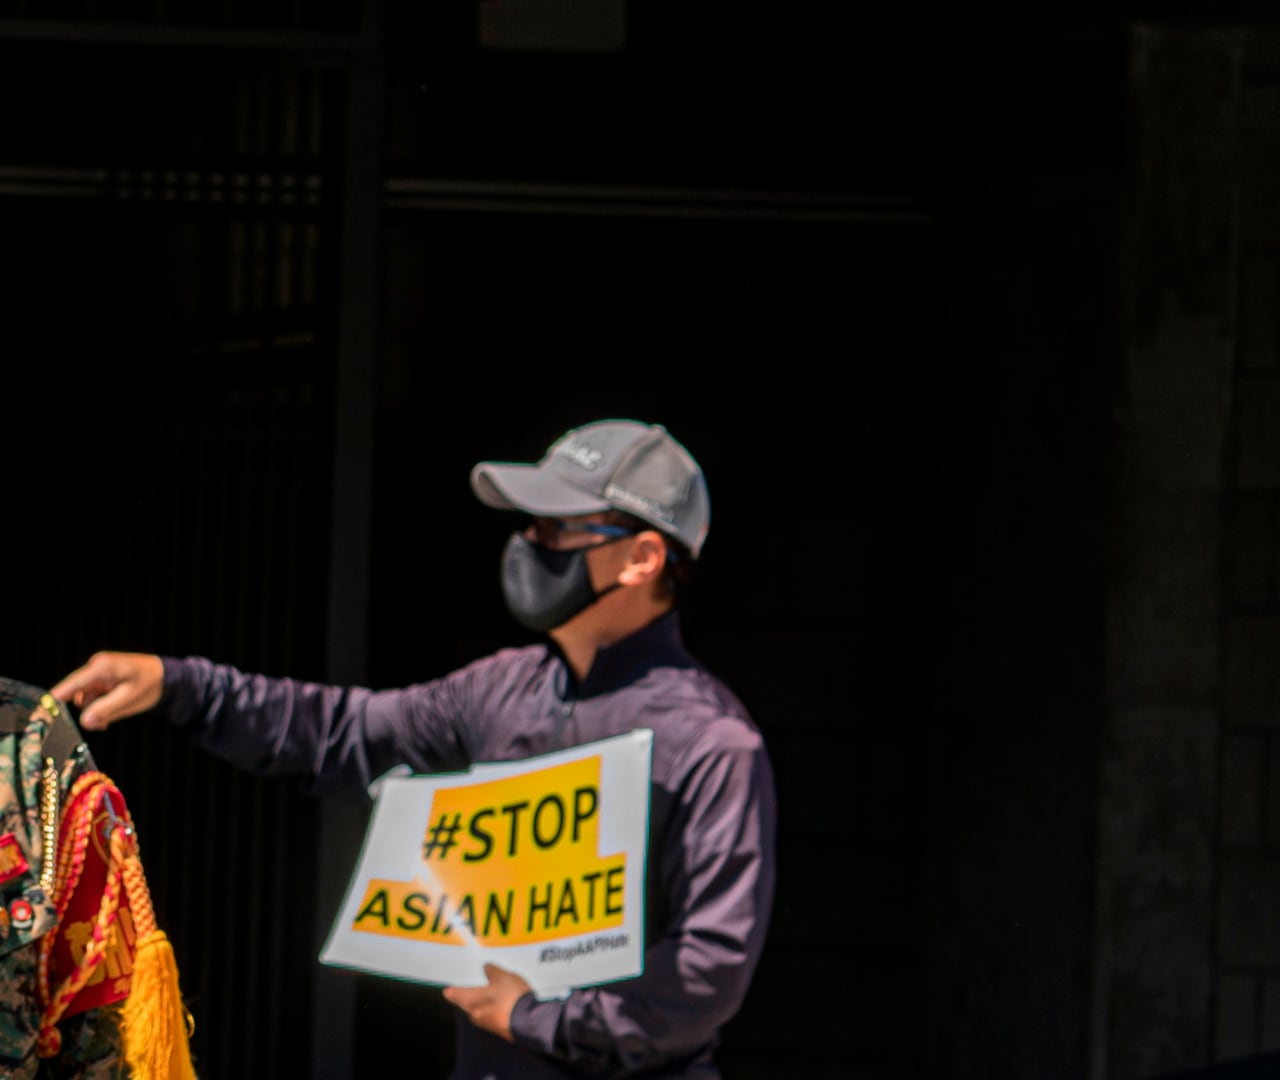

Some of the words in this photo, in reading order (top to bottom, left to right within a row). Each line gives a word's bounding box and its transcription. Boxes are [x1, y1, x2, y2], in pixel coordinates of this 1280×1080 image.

[423, 785, 600, 863] #STOP
[354, 888, 514, 937] ASIAN
[527, 865, 625, 933] HATE
